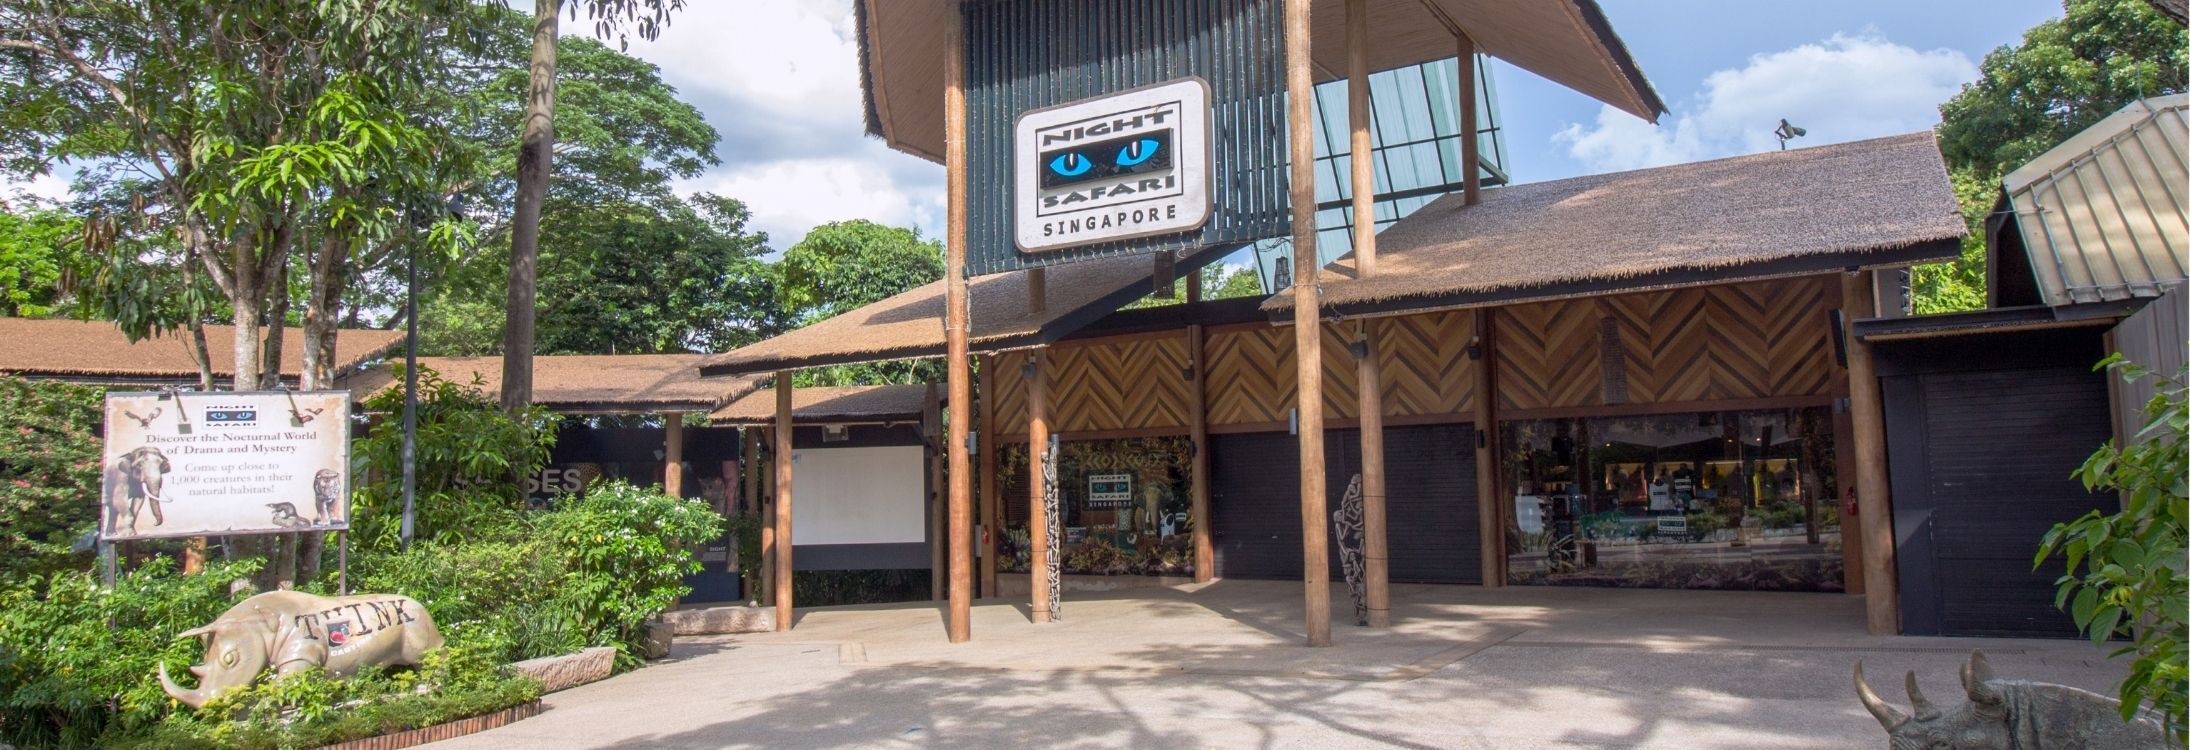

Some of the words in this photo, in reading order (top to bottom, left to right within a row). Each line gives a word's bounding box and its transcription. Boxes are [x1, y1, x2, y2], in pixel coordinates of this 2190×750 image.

[1042, 109, 1174, 147] NIGHT
[1043, 175, 1176, 209] SAFARI
[1043, 204, 1176, 237] SINGAPORE
[146, 434, 199, 443] Discover
[201, 433, 219, 442] the
[223, 432, 281, 441] Nocturnal
[284, 431, 317, 440] World
[166, 446, 180, 454] of
[184, 445, 224, 454] Drama
[227, 444, 249, 453] and
[252, 444, 298, 455] Mystery
[184, 463, 218, 472] Come
[221, 464, 235, 473] up
[238, 461, 266, 471] close
[268, 462, 280, 470] to
[171, 475, 200, 486] 1,000
[203, 475, 252, 484] creatures
[255, 473, 265, 482] in
[268, 472, 294, 481] their
[188, 486, 226, 496] natural
[230, 484, 275, 495] habitats!
